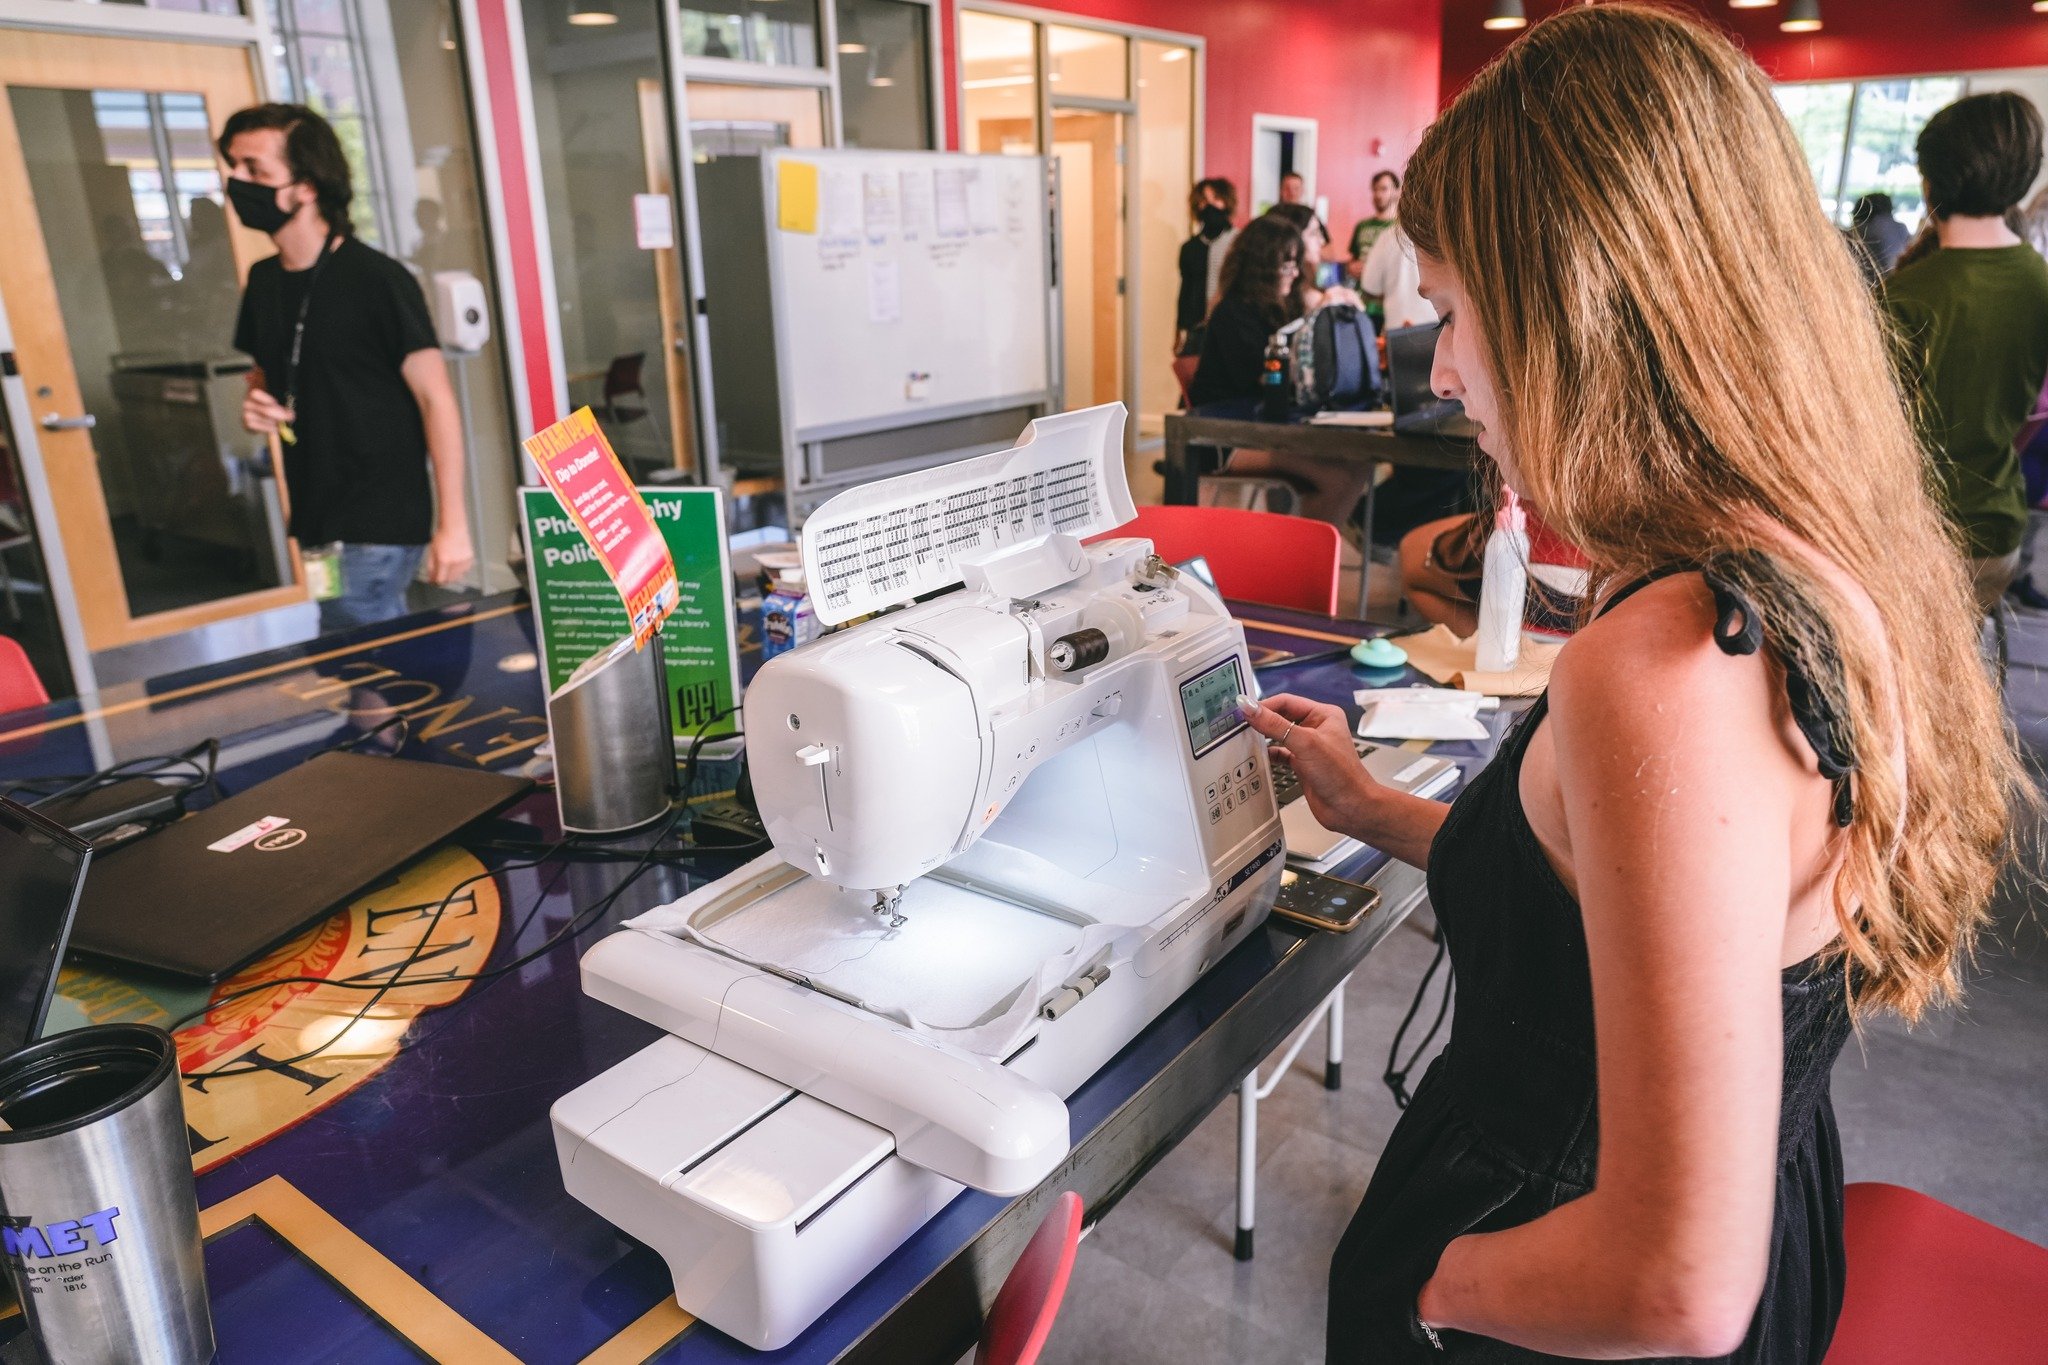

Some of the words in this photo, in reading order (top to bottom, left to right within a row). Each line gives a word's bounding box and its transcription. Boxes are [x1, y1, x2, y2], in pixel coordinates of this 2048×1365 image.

[555, 467, 571, 483] Dip
[574, 446, 600, 472] Donate!
[543, 541, 601, 566] Polic
[679, 620, 710, 629] Library's
[38, 1266, 56, 1275] on
[58, 1262, 82, 1273] the
[85, 1252, 114, 1267] Run
[63, 1282, 88, 1293] 1816
